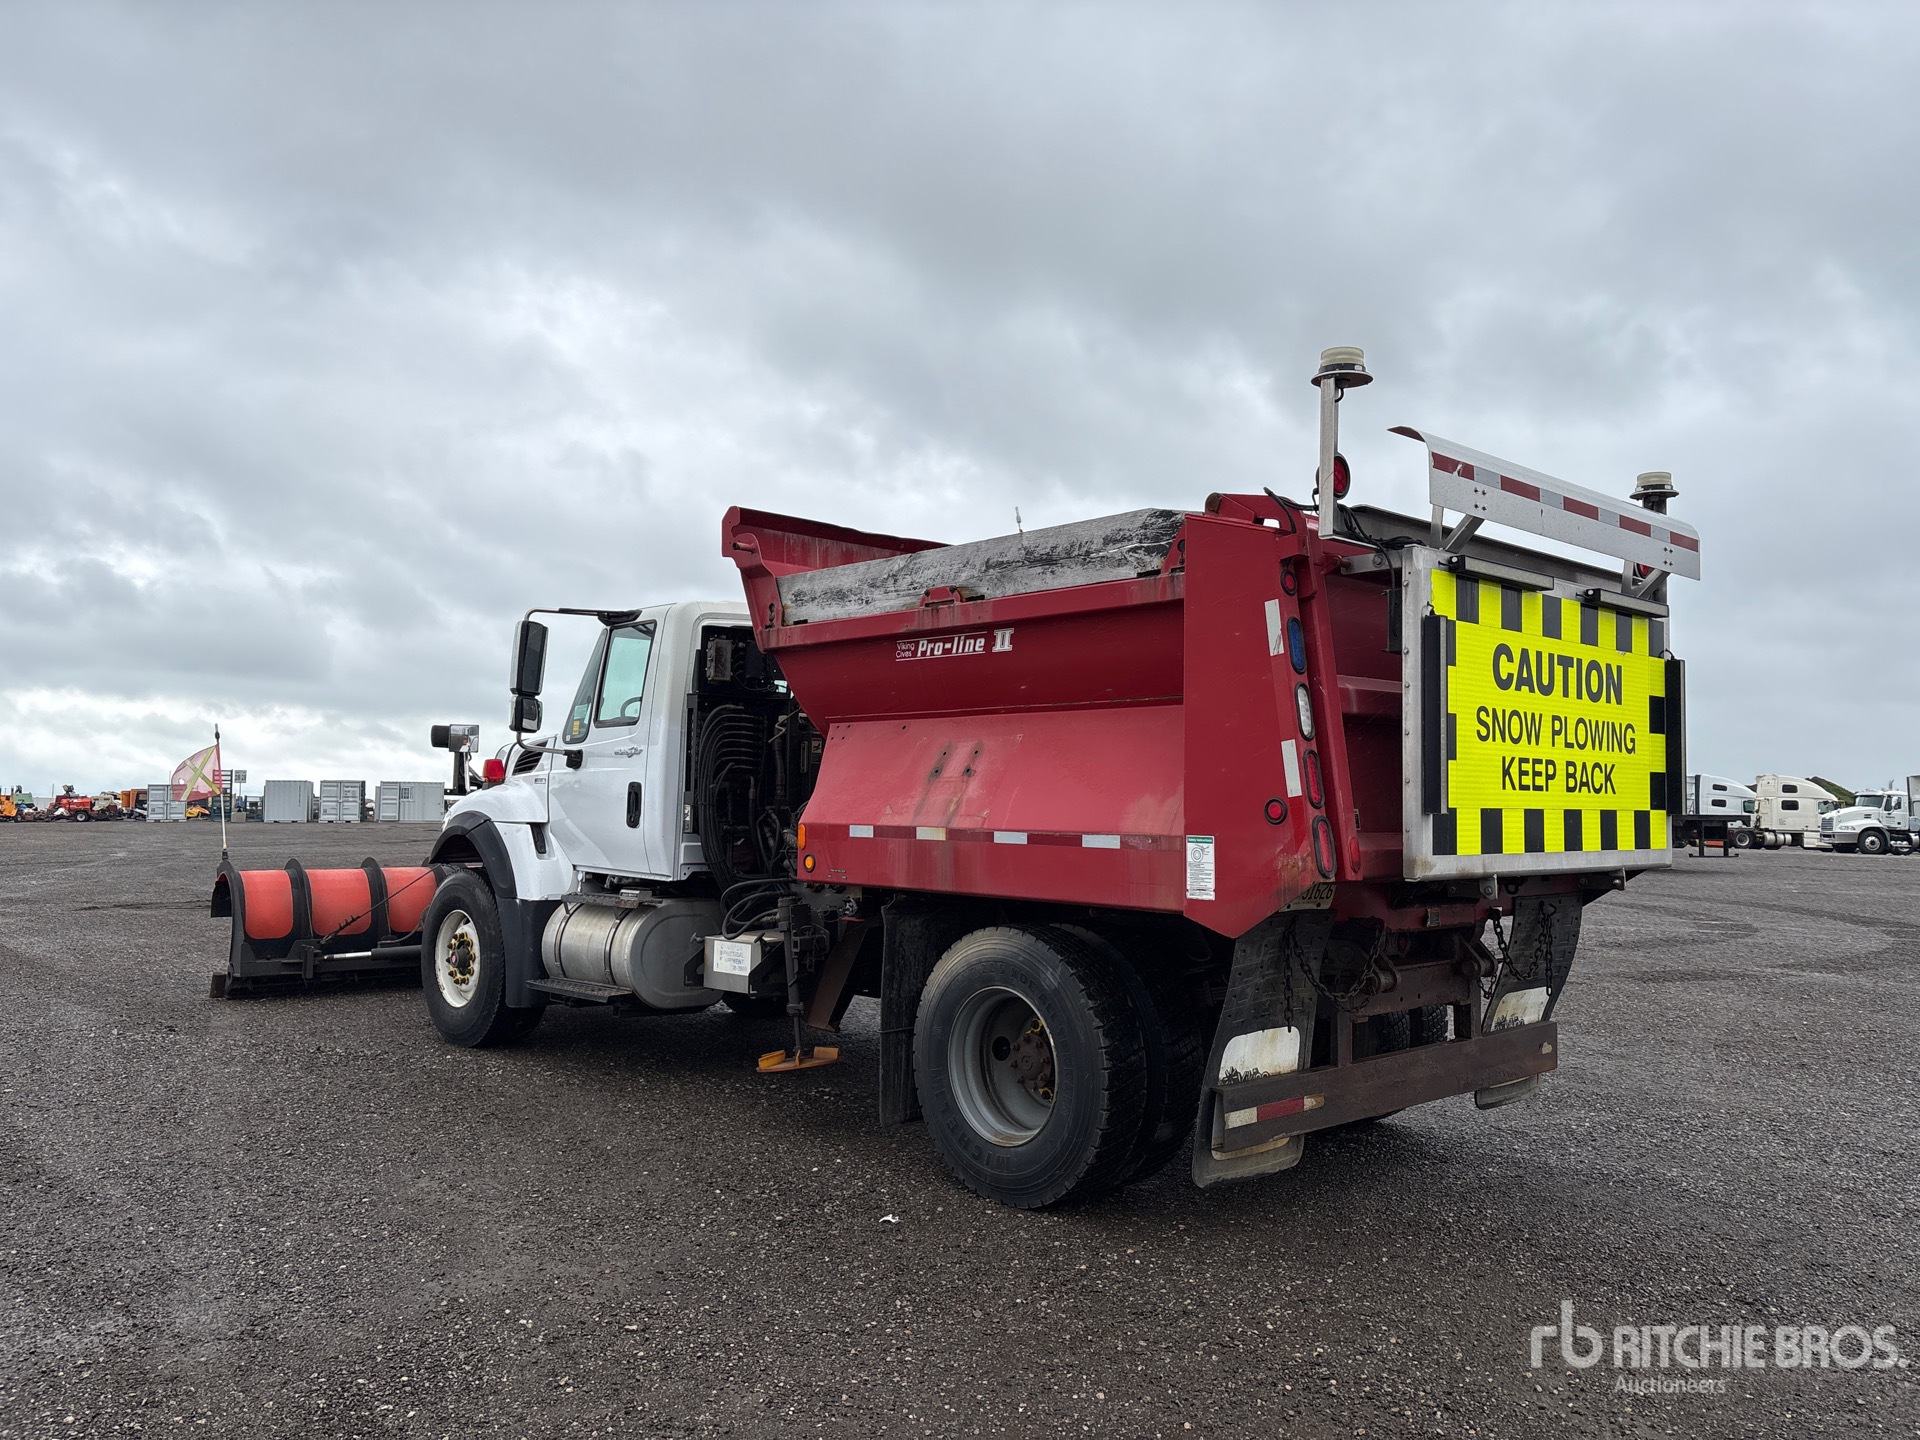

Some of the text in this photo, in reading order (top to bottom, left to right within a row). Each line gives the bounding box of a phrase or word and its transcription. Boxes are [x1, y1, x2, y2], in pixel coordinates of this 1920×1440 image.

[895, 650, 912, 658] Cives
[896, 641, 915, 651] Viking
[916, 635, 986, 657] Pro-line
[1493, 643, 1622, 705] CAUTION
[1476, 705, 1636, 754] SNOW PLOWING
[1501, 756, 1616, 795] KEEP BACK
[929, 1067, 1011, 1174] MICHELIN
